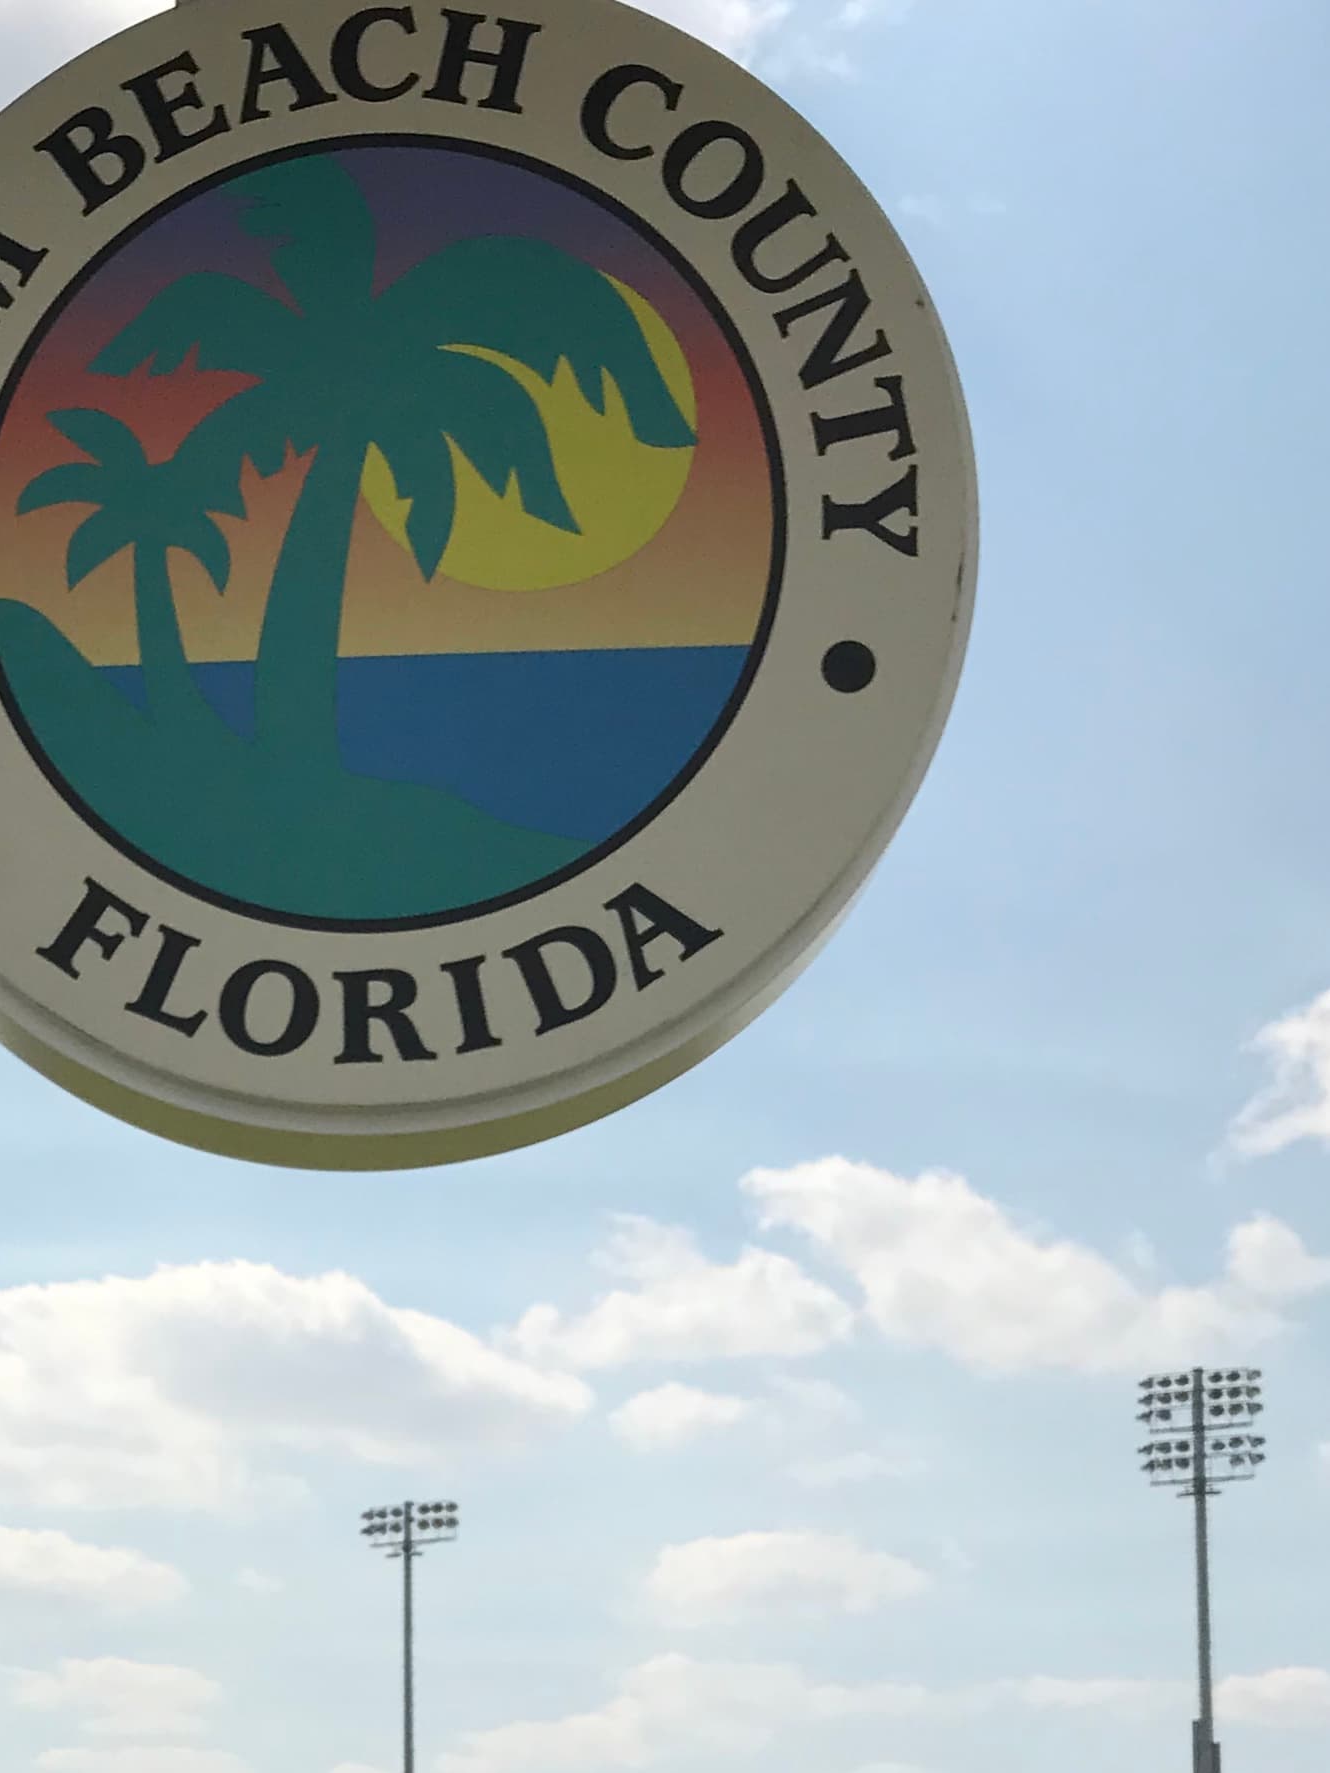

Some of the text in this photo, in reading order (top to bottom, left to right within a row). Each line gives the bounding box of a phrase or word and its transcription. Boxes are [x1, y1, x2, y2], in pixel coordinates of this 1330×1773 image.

[32, 5, 543, 219] BEACH
[578, 61, 920, 558] COUNTY
[36, 879, 724, 1066] FLORIDA
